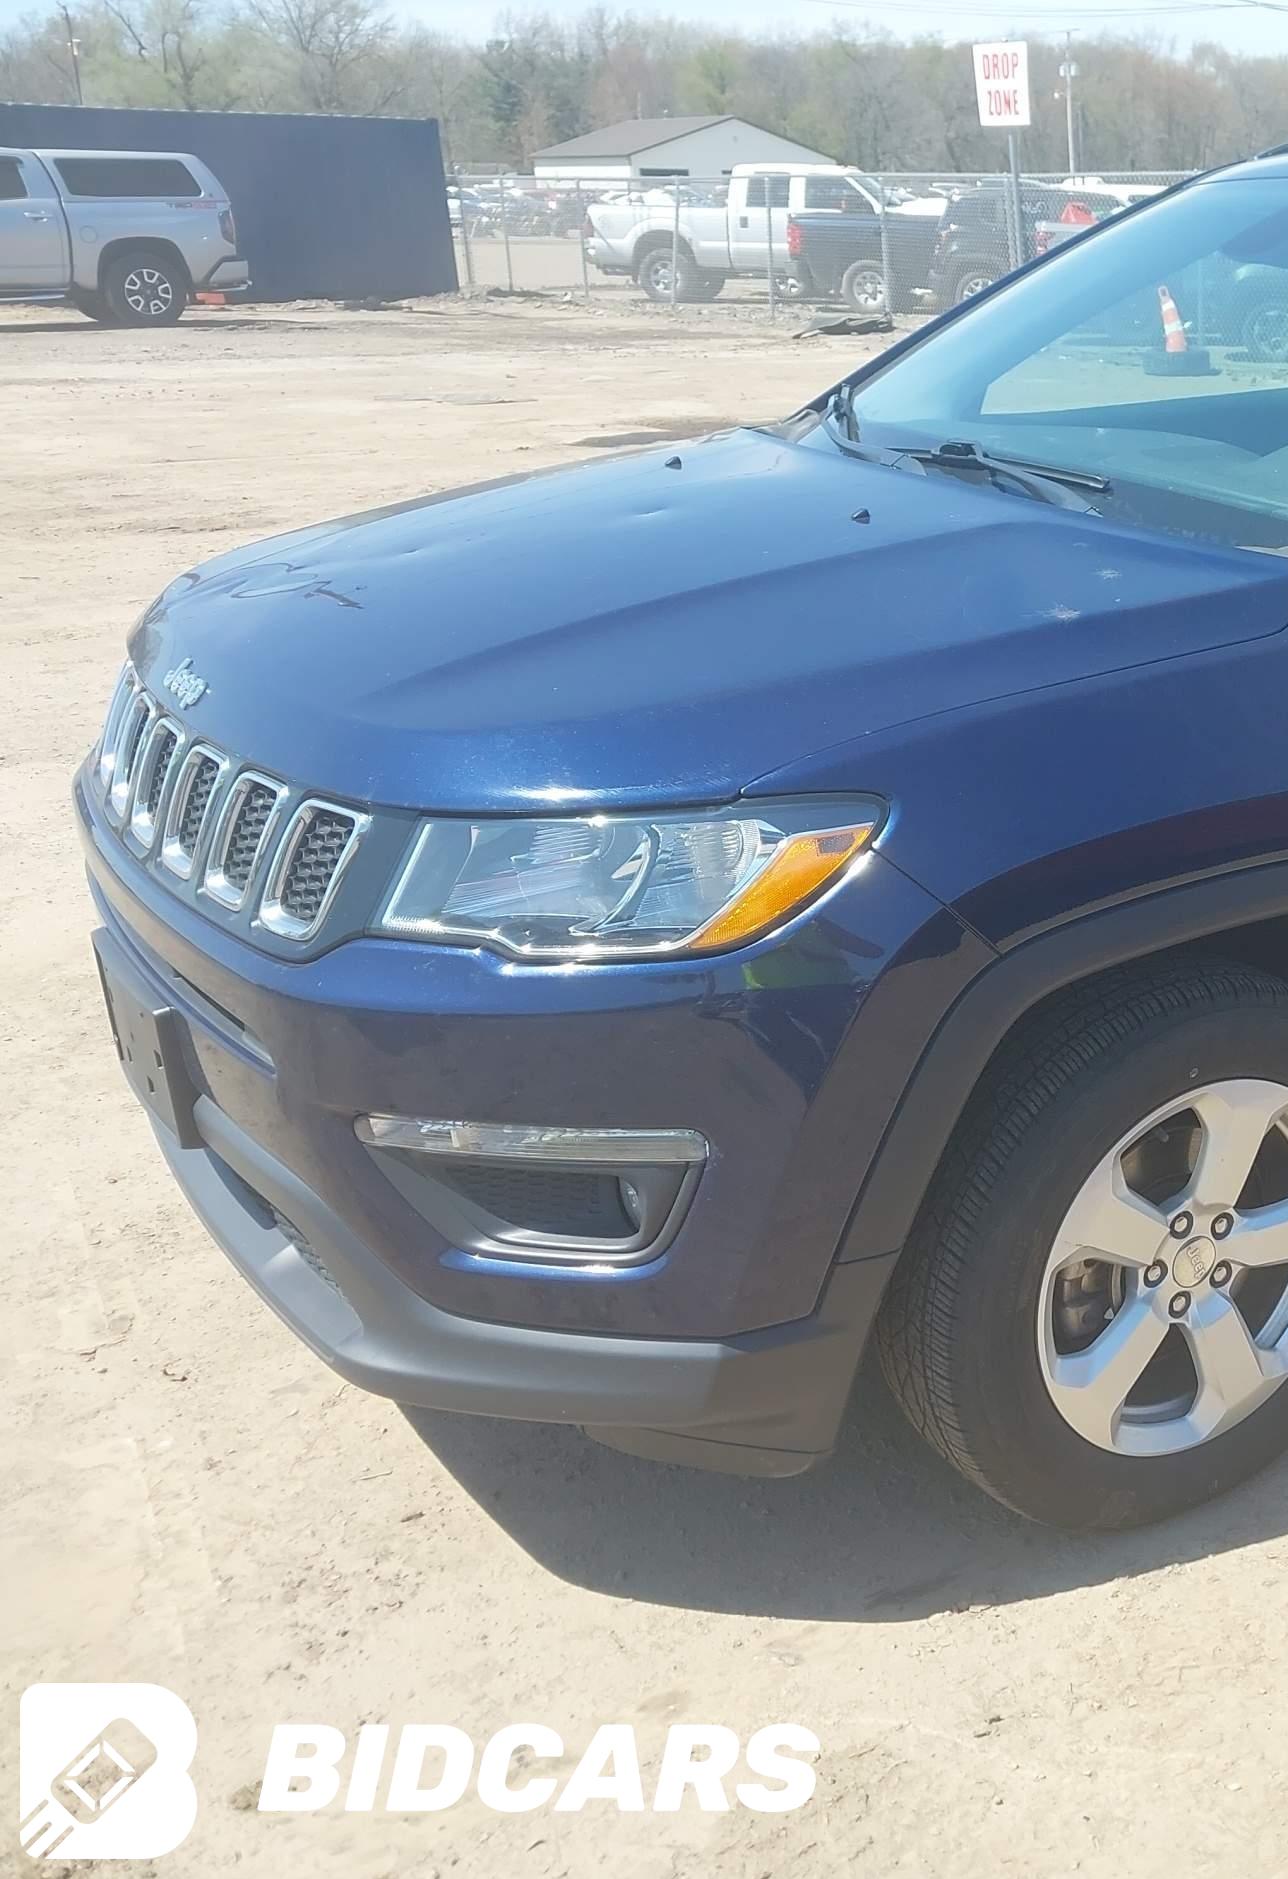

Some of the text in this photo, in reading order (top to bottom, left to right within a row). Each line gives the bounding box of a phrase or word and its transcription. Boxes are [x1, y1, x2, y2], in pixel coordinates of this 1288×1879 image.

[982, 52, 1019, 80] DROP
[987, 89, 1019, 116] ZONE
[163, 657, 206, 708] Jeep
